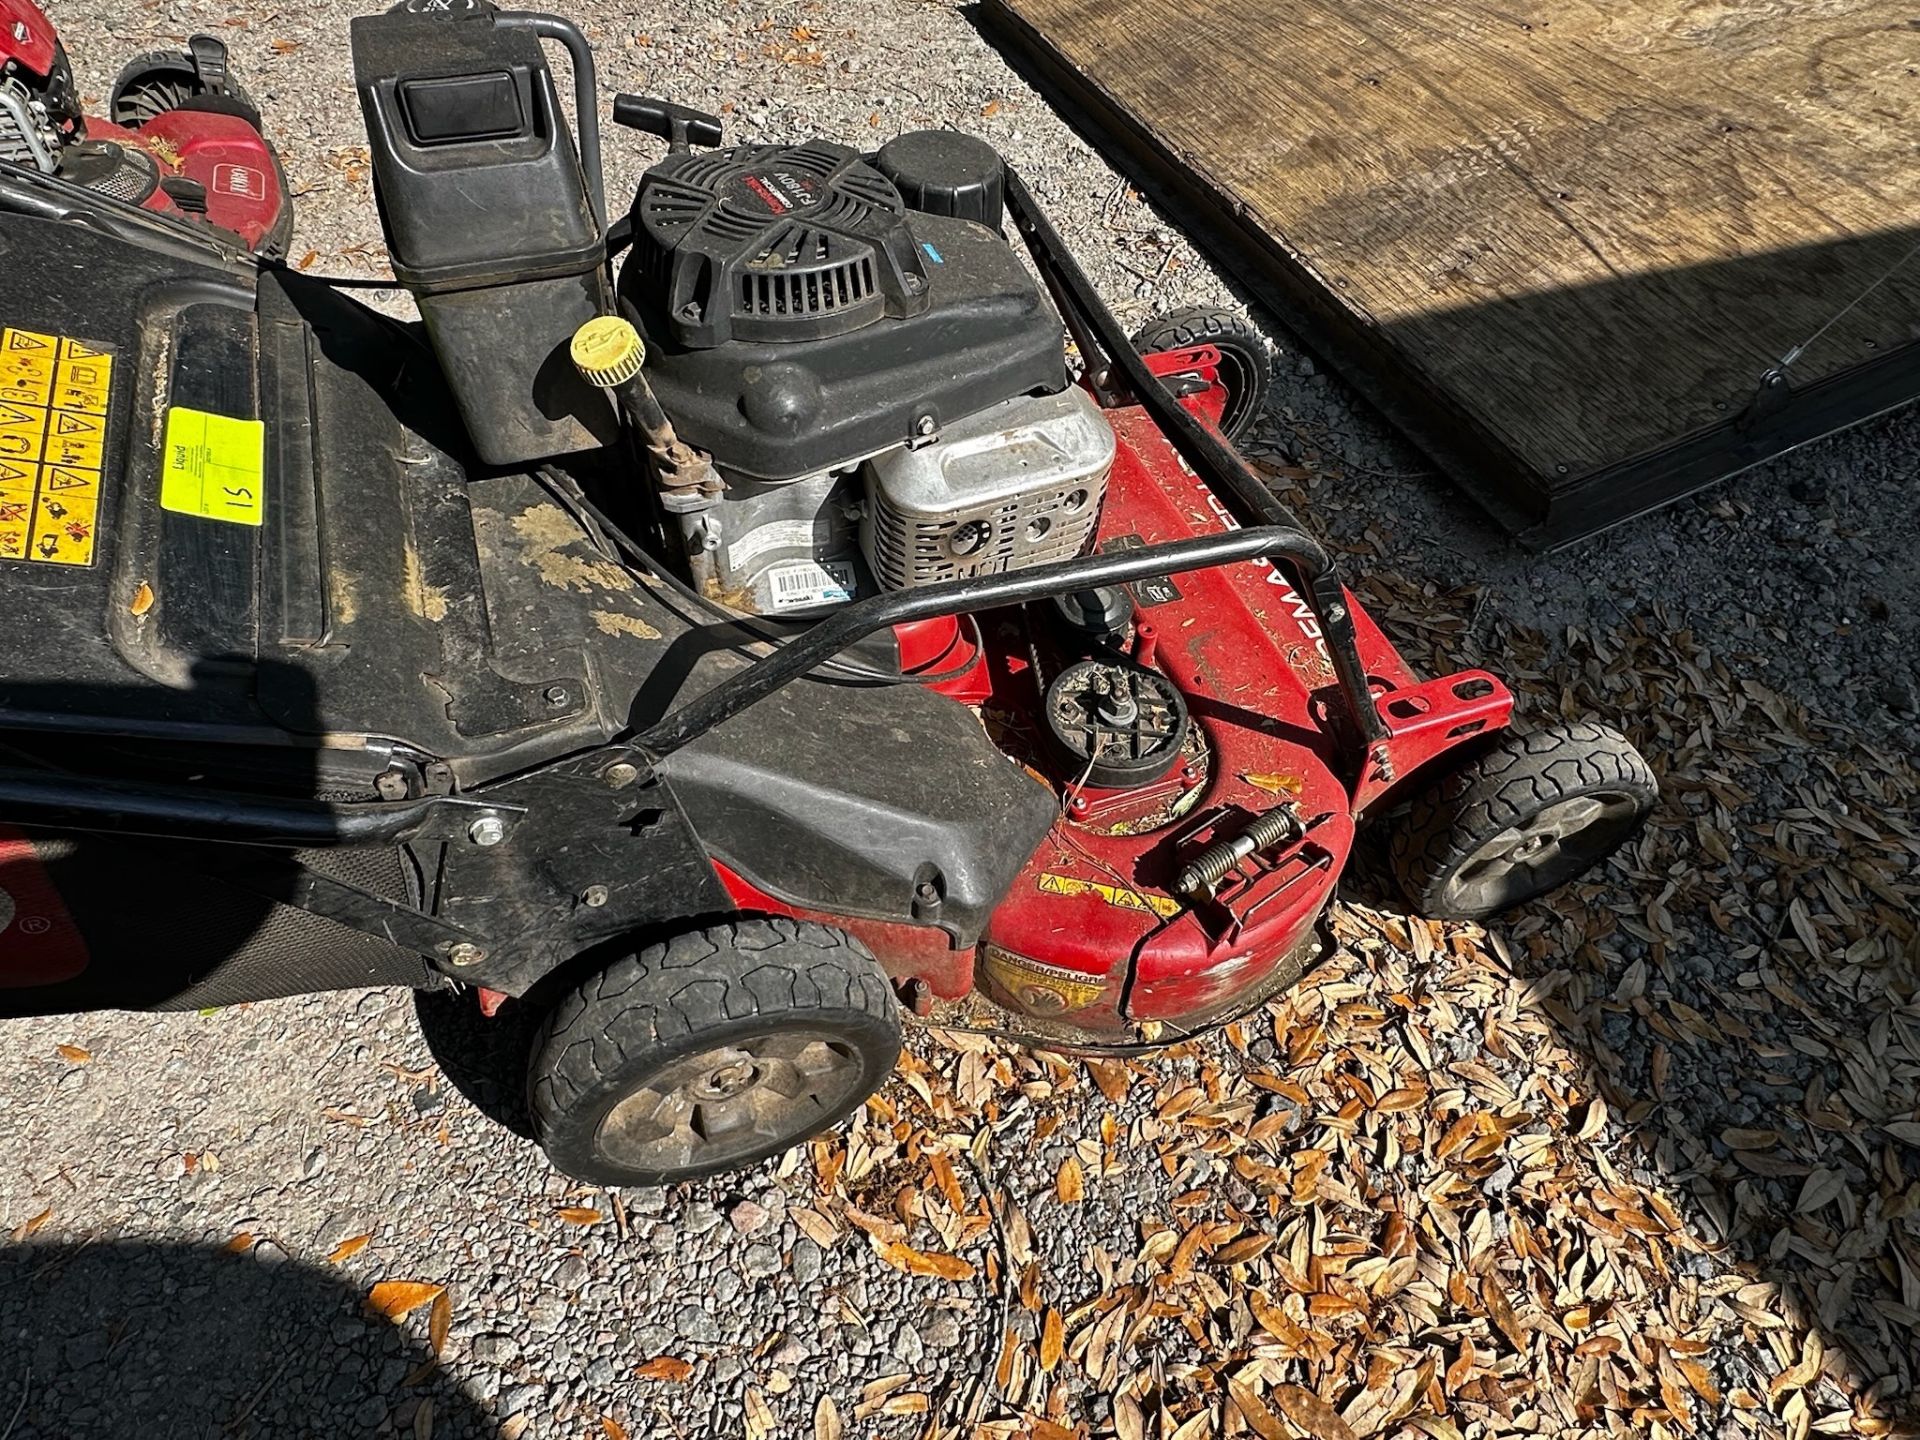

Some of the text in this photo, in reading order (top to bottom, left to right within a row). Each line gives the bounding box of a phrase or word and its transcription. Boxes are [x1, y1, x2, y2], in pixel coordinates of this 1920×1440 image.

[230, 167, 249, 193] TORO
[743, 175, 786, 215] Kawasaki
[760, 176, 794, 209] COMMERCIAL
[773, 172, 817, 206] FJ180V
[222, 486, 254, 508] 15
